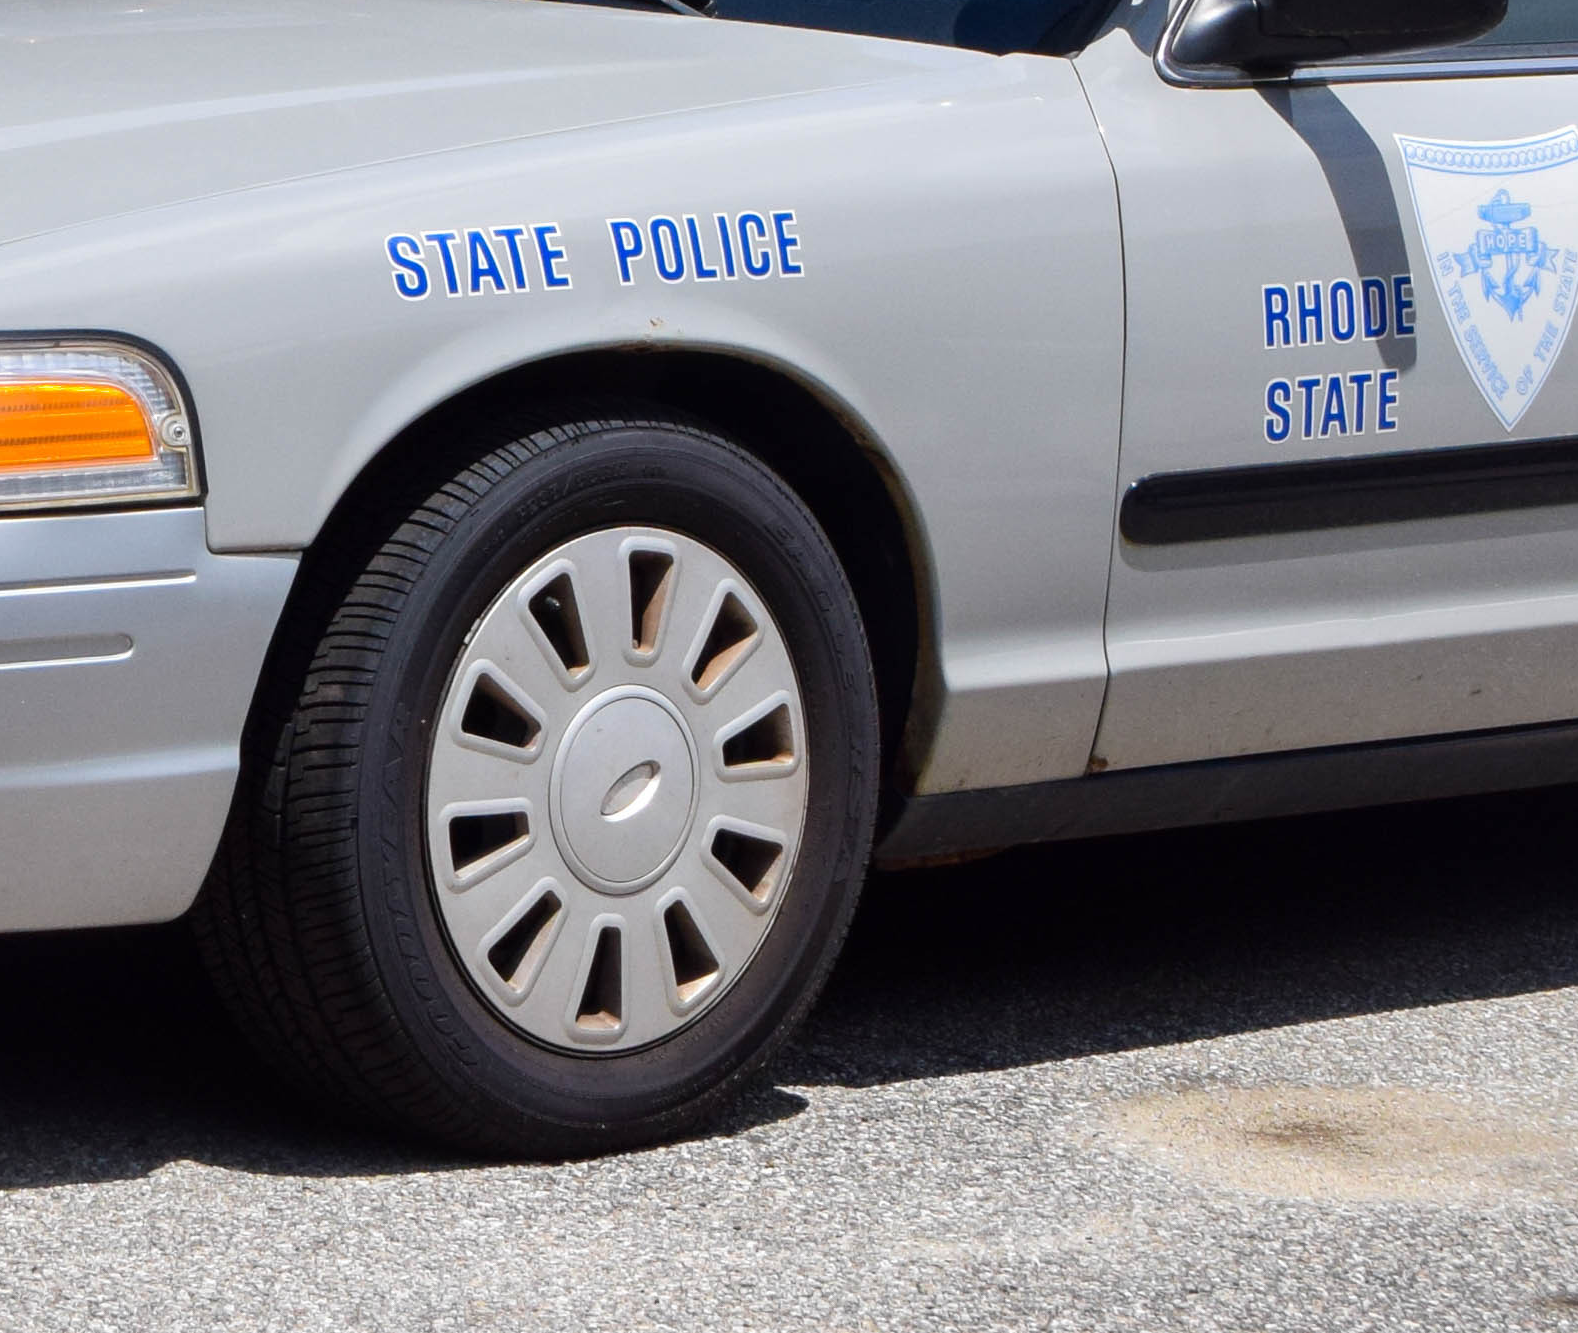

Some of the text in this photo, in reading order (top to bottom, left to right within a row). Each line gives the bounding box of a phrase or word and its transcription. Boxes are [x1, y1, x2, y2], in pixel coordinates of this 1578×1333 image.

[386, 209, 805, 301] STATE POLICE
[1485, 233, 1528, 250] HOPE
[1261, 273, 1416, 350] RHODE
[1264, 369, 1400, 444] STATE
